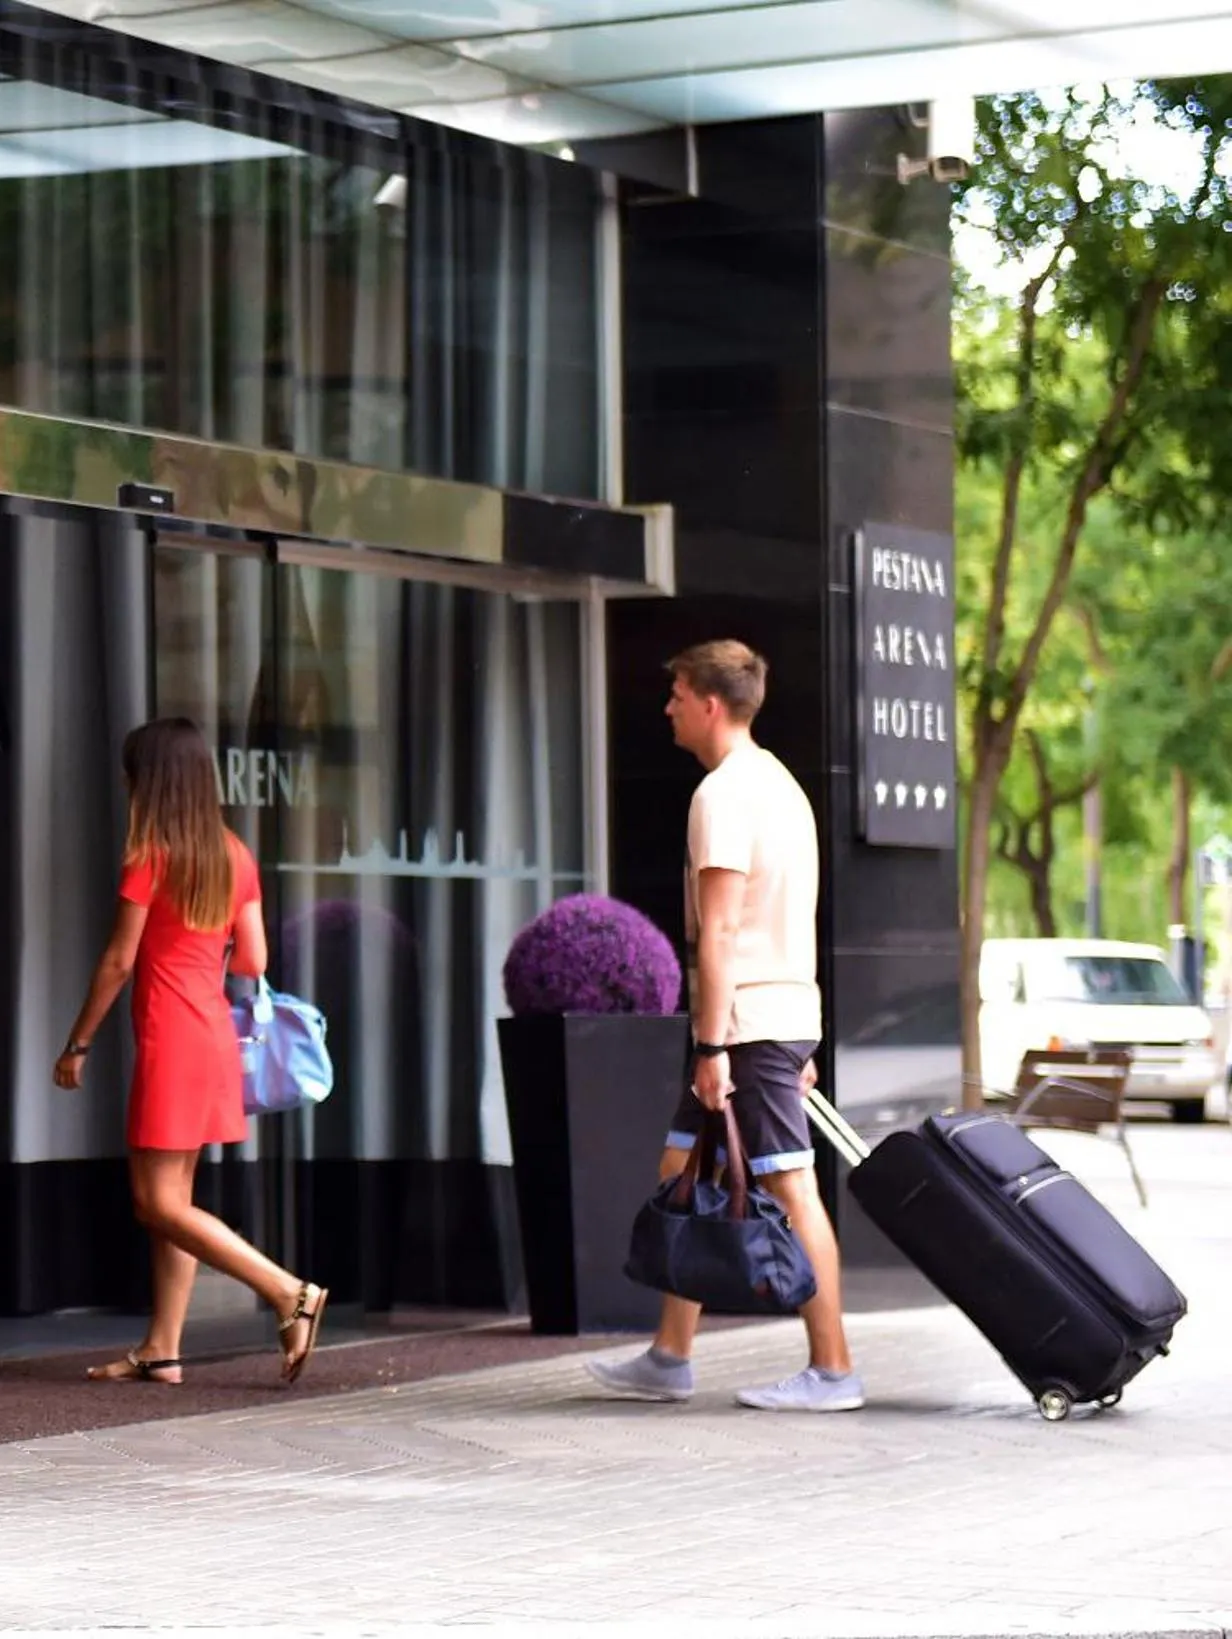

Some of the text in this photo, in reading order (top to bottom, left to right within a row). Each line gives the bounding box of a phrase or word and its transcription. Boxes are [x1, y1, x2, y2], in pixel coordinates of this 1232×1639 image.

[872, 546, 946, 598] PESTANA
[873, 624, 947, 671] ARENA
[873, 697, 947, 742] HOTEL
